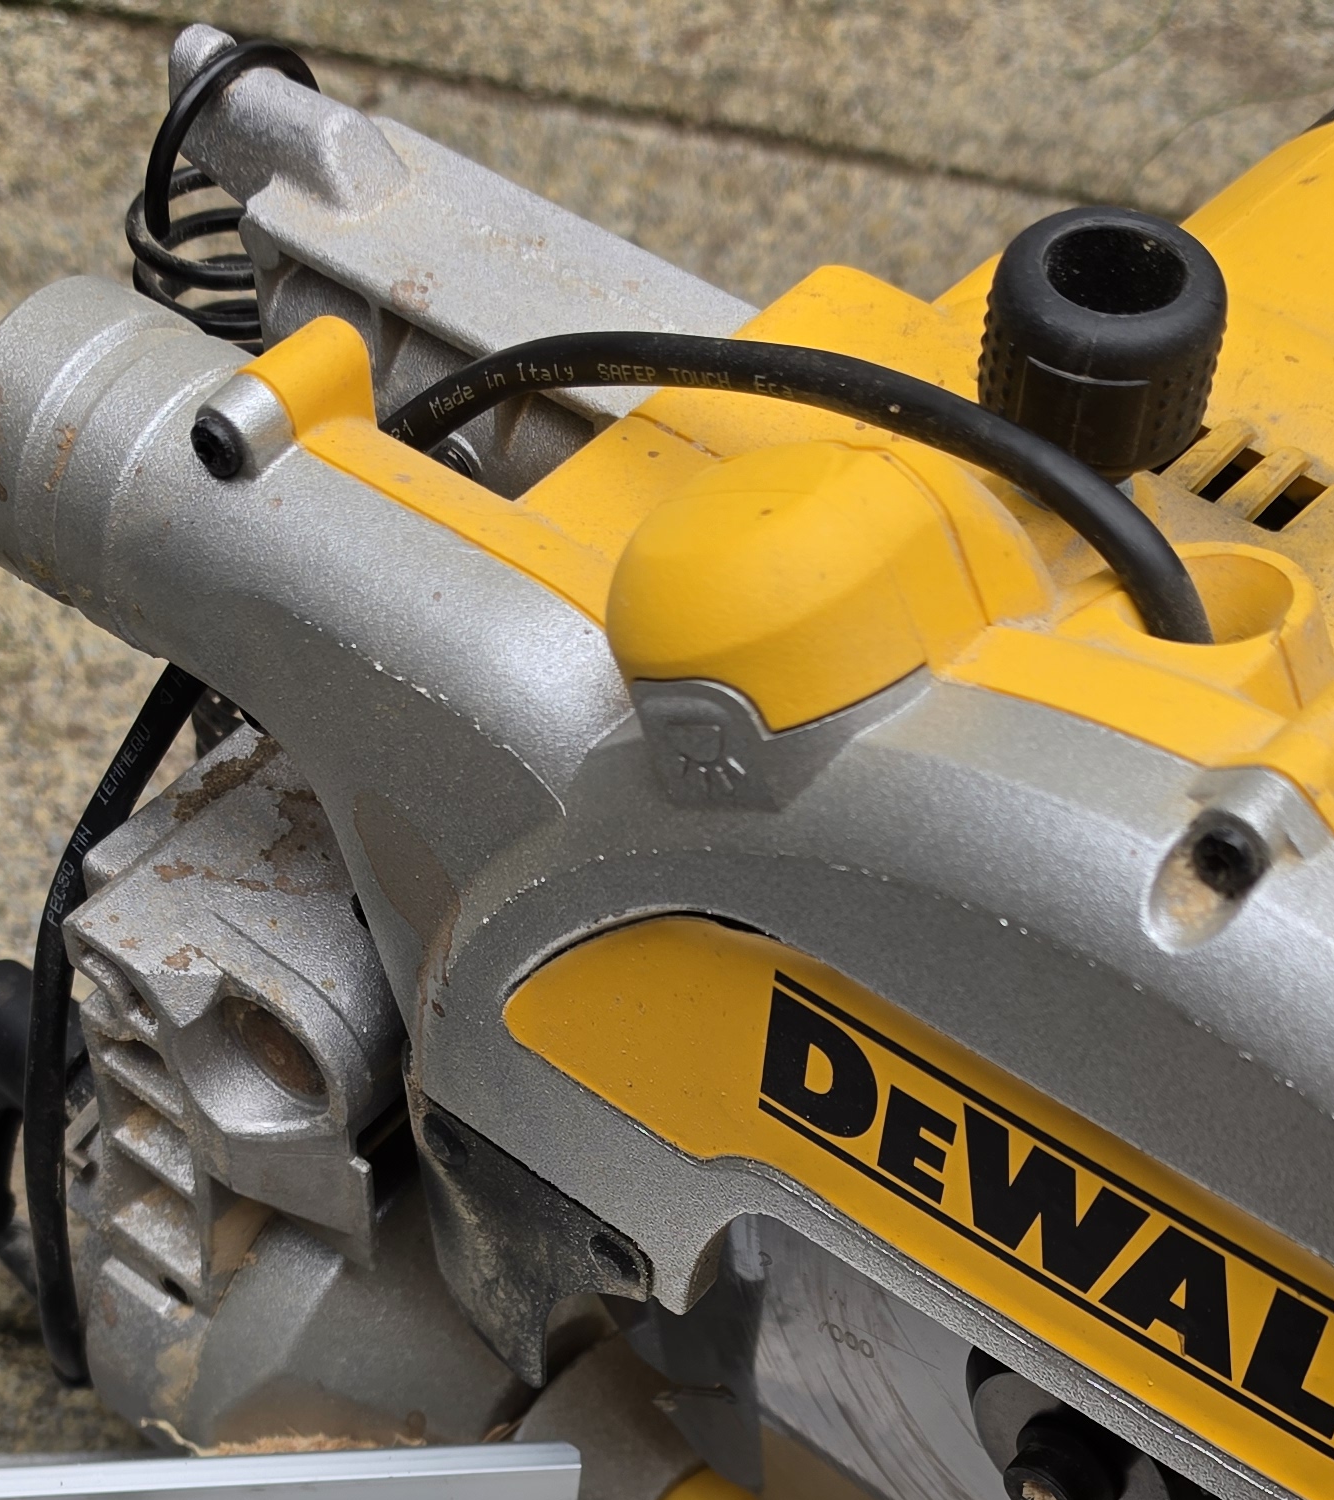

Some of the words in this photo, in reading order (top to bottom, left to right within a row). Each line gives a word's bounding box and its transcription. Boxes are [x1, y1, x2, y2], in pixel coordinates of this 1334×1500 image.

[428, 383, 475, 419] Made
[484, 370, 506, 389] in
[517, 362, 574, 382] Italy
[668, 367, 731, 389] TOUCH
